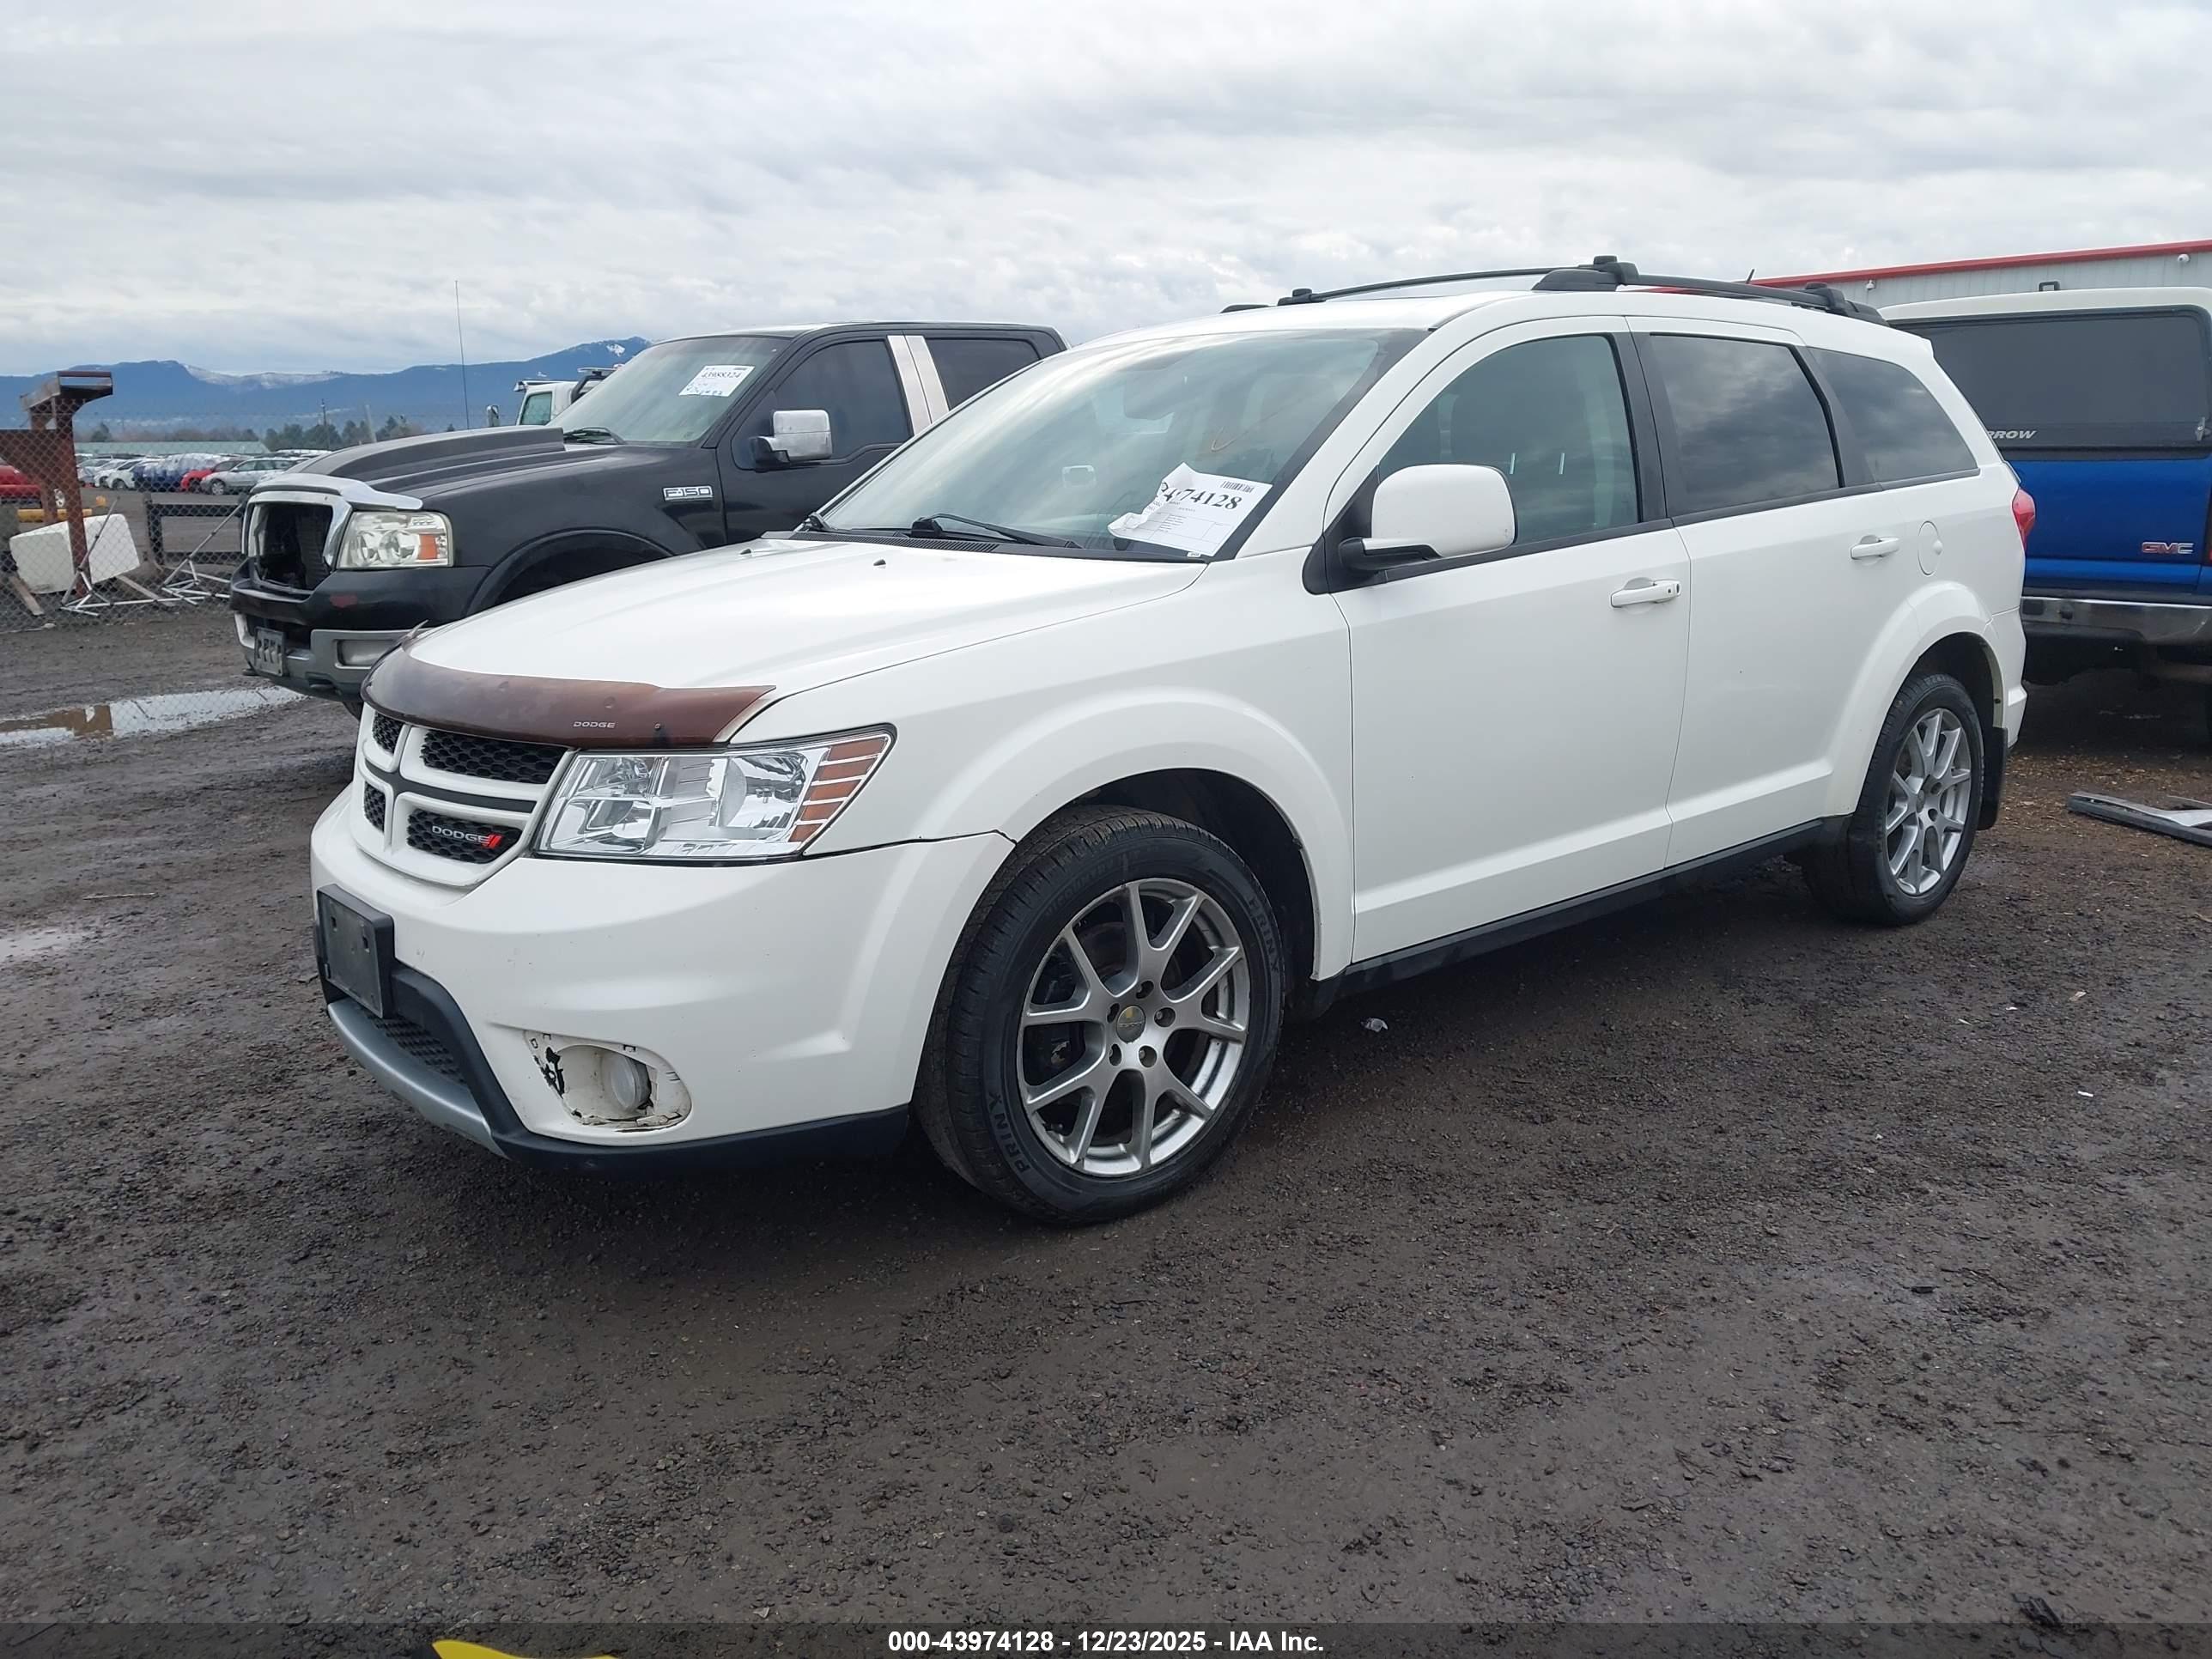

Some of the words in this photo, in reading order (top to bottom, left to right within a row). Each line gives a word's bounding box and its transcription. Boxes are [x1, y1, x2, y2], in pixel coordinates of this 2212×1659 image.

[665, 487, 712, 497] F-150
[2142, 542, 2195, 555] GMC
[432, 825, 491, 844] DODGE
[988, 1091, 1031, 1173] PRINX
